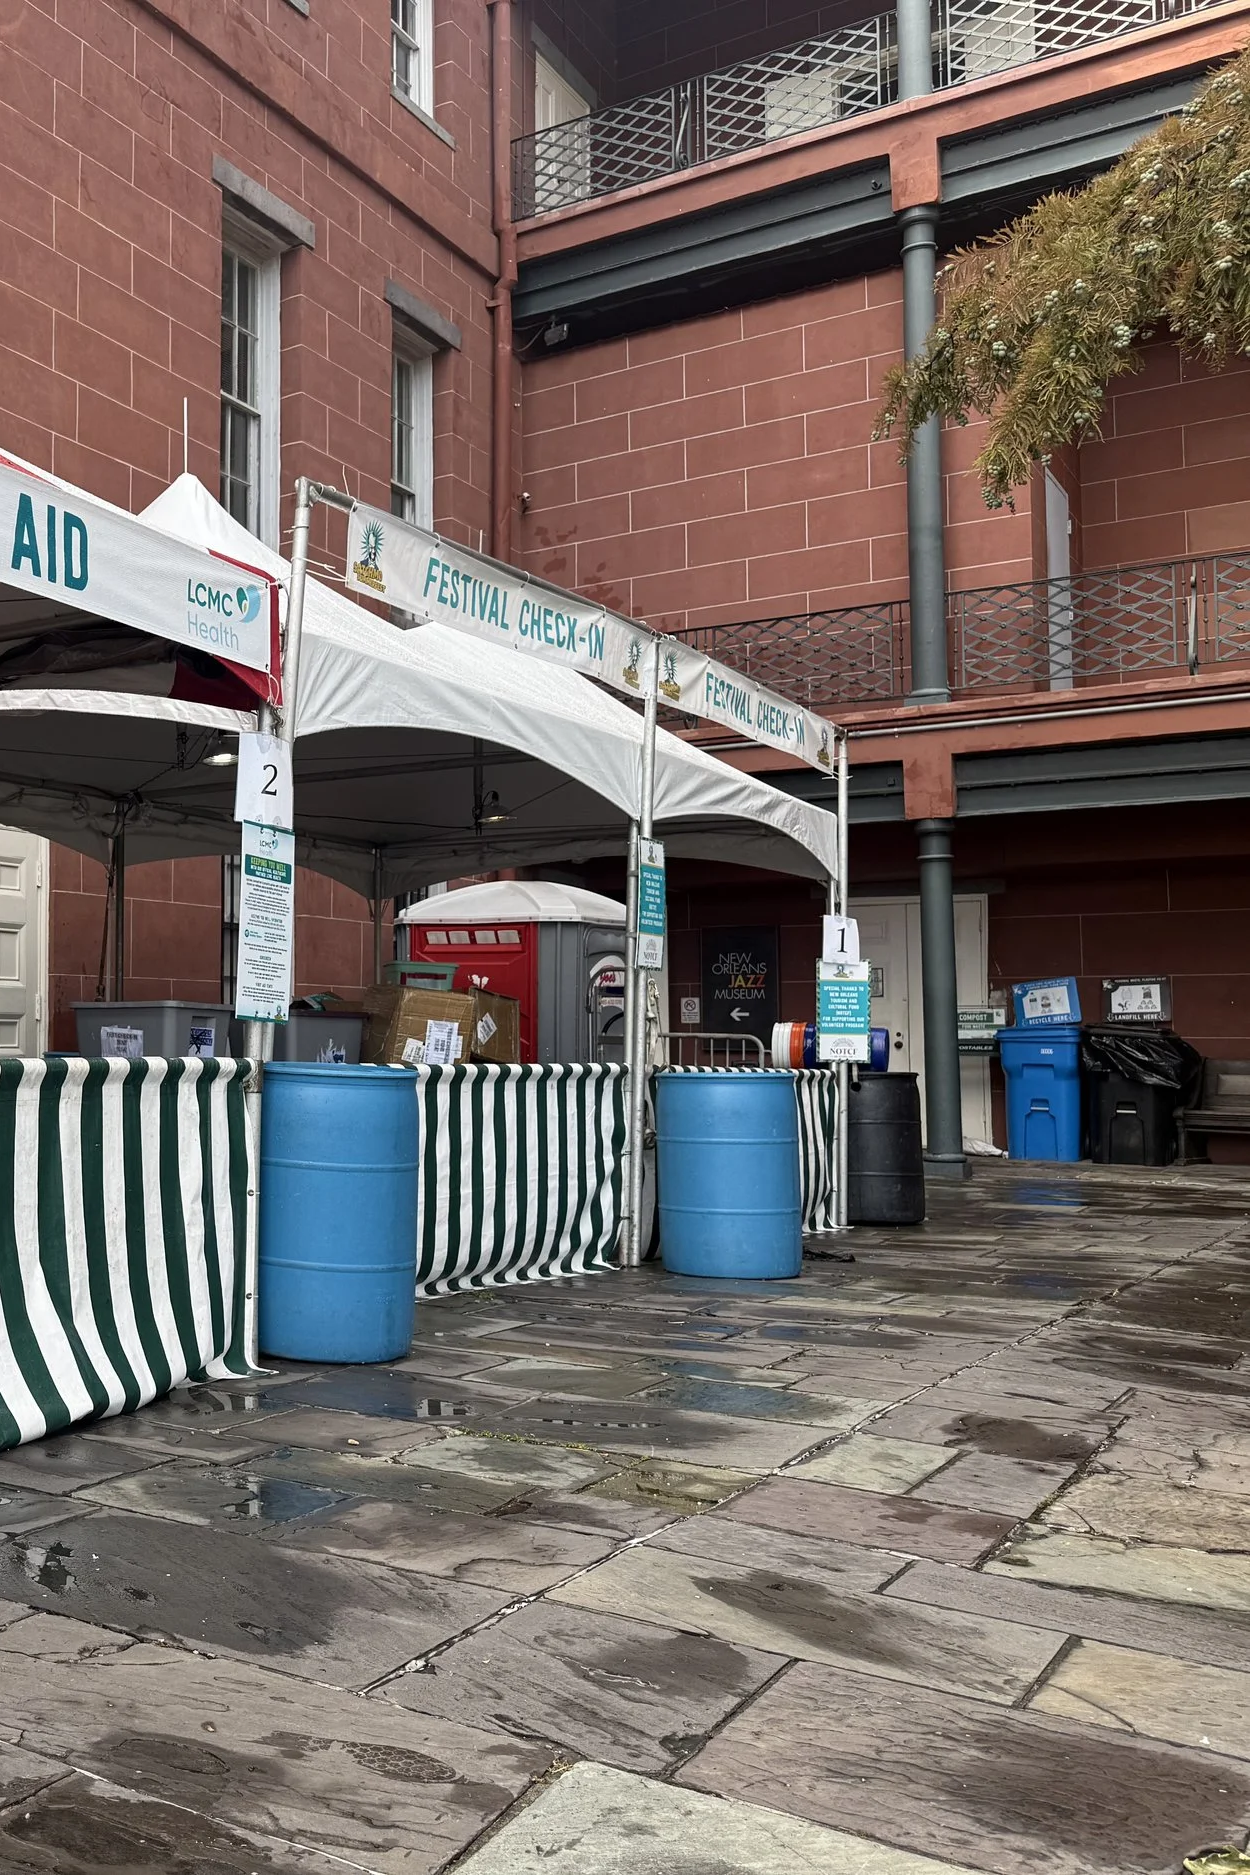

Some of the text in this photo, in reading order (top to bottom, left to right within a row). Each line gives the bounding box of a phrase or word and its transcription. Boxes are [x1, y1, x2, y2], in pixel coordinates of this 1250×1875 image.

[10, 491, 90, 592] AID
[187, 577, 234, 618] LCMC
[423, 556, 606, 661] FESTIVAL CHECK-IN
[187, 610, 240, 652] Health
[705, 671, 753, 726] FESTIVAL
[757, 699, 806, 746] CHECK-IN
[261, 763, 278, 797] 2
[837, 927, 848, 954] 1
[711, 962, 767, 975] ORLEANS
[719, 952, 752, 963] NEW
[714, 988, 766, 999] MUSEUM
[728, 974, 766, 988] JAZZ
[959, 1013, 988, 1021] COMPOST
[1028, 1014, 1069, 1025] RECYCLE HERE
